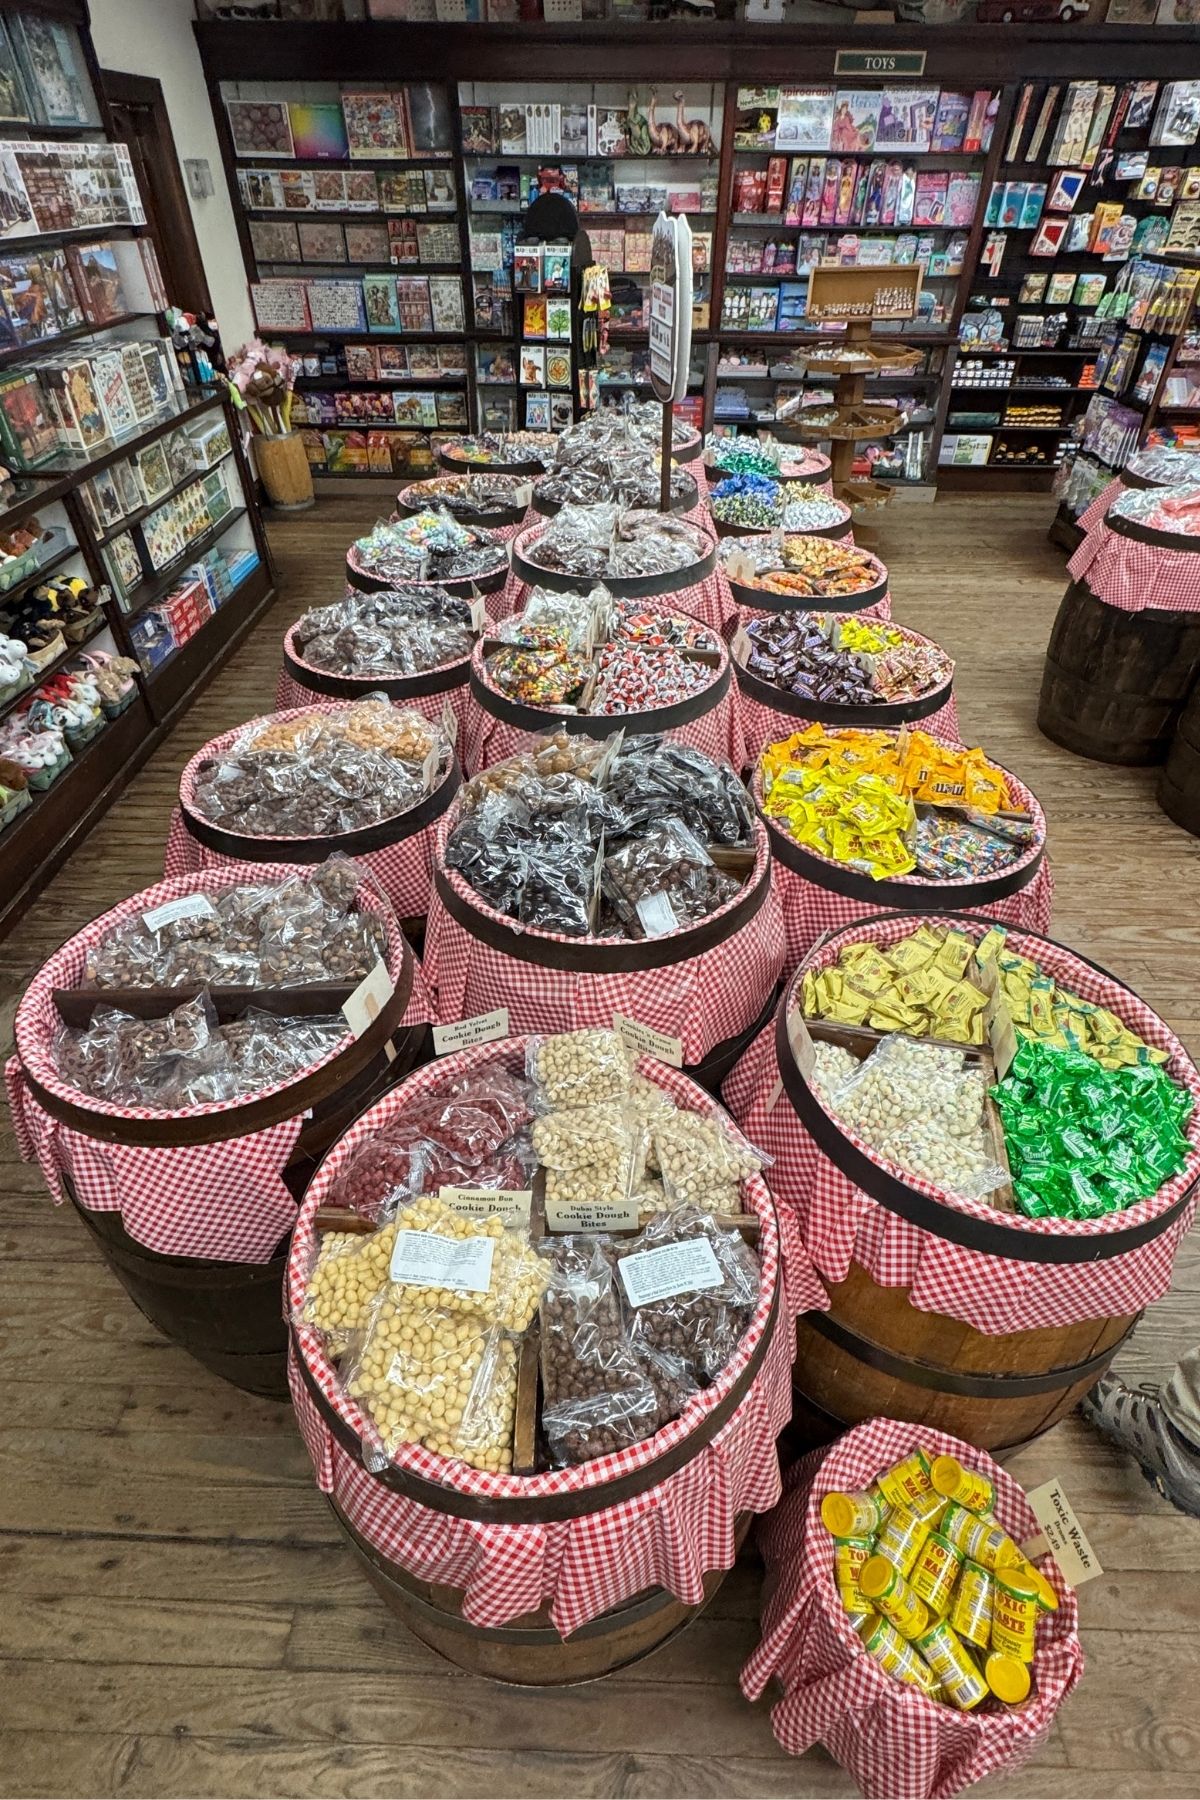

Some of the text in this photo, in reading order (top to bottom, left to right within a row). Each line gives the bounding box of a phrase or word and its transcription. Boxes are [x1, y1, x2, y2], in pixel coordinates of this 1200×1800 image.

[864, 57, 896, 70] TOYS
[469, 1018, 488, 1028] Velvet
[622, 1019, 645, 1035] Cookies
[442, 1021, 501, 1042] Cookie Dough
[462, 1036, 483, 1046] Bites
[620, 1026, 675, 1055] Cookie Dough
[637, 1042, 657, 1056] Bites
[458, 1194, 496, 1202] Cinnamon
[448, 1202, 485, 1212] Cookie
[556, 1211, 630, 1220] Cookie Dough
[581, 1220, 607, 1228] Bites
[1049, 1488, 1091, 1569] Toxic Waste
[997, 1592, 1027, 1614] OXIC
[996, 1609, 1026, 1632] ASTE
